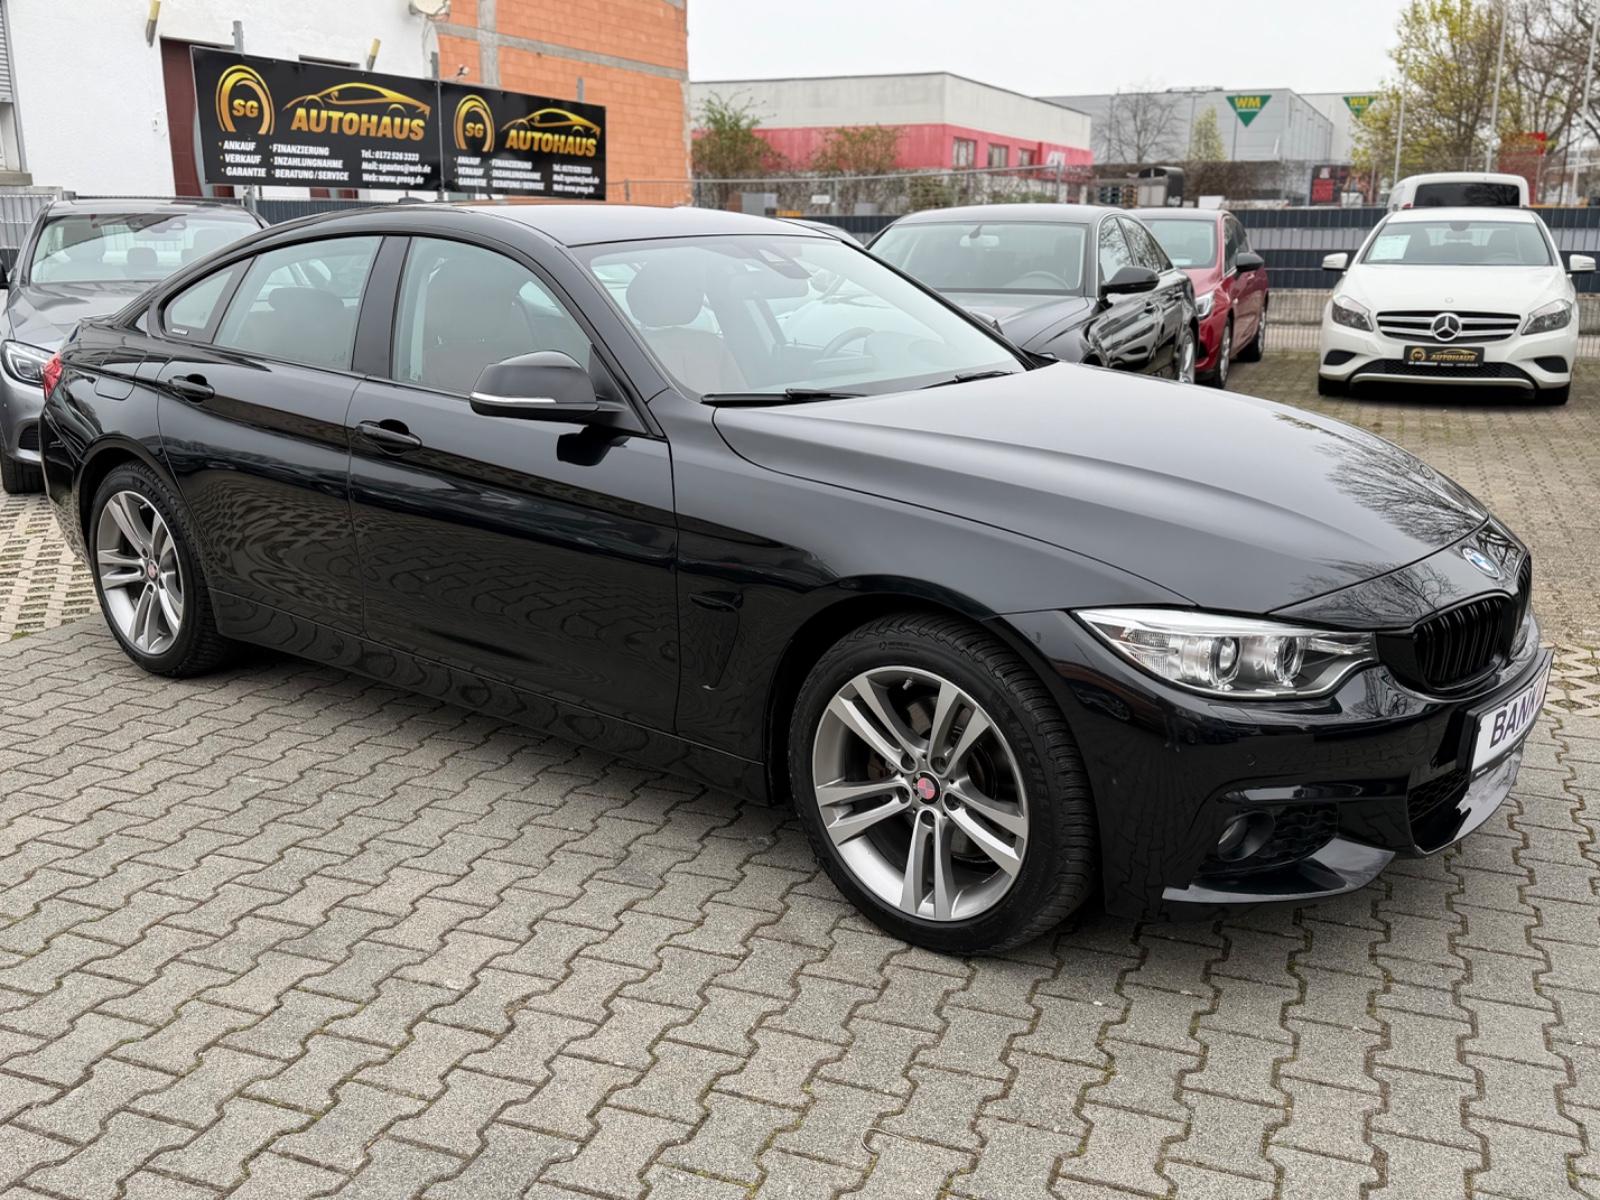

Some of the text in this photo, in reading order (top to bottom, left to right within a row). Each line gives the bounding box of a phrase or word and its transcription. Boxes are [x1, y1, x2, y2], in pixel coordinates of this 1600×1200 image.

[232, 98, 259, 118] SG
[1235, 96, 1261, 109] WM
[290, 107, 425, 141] AUTOHAUS
[465, 122, 484, 138] SG
[223, 140, 256, 151] ANKAUF
[272, 143, 330, 156] FINANZIERUNG
[505, 129, 597, 157] AUTOHAUS
[224, 153, 262, 165] VERKAUF
[273, 156, 344, 169] INZAHLUNGNAHME
[225, 166, 267, 178] GARANTIE
